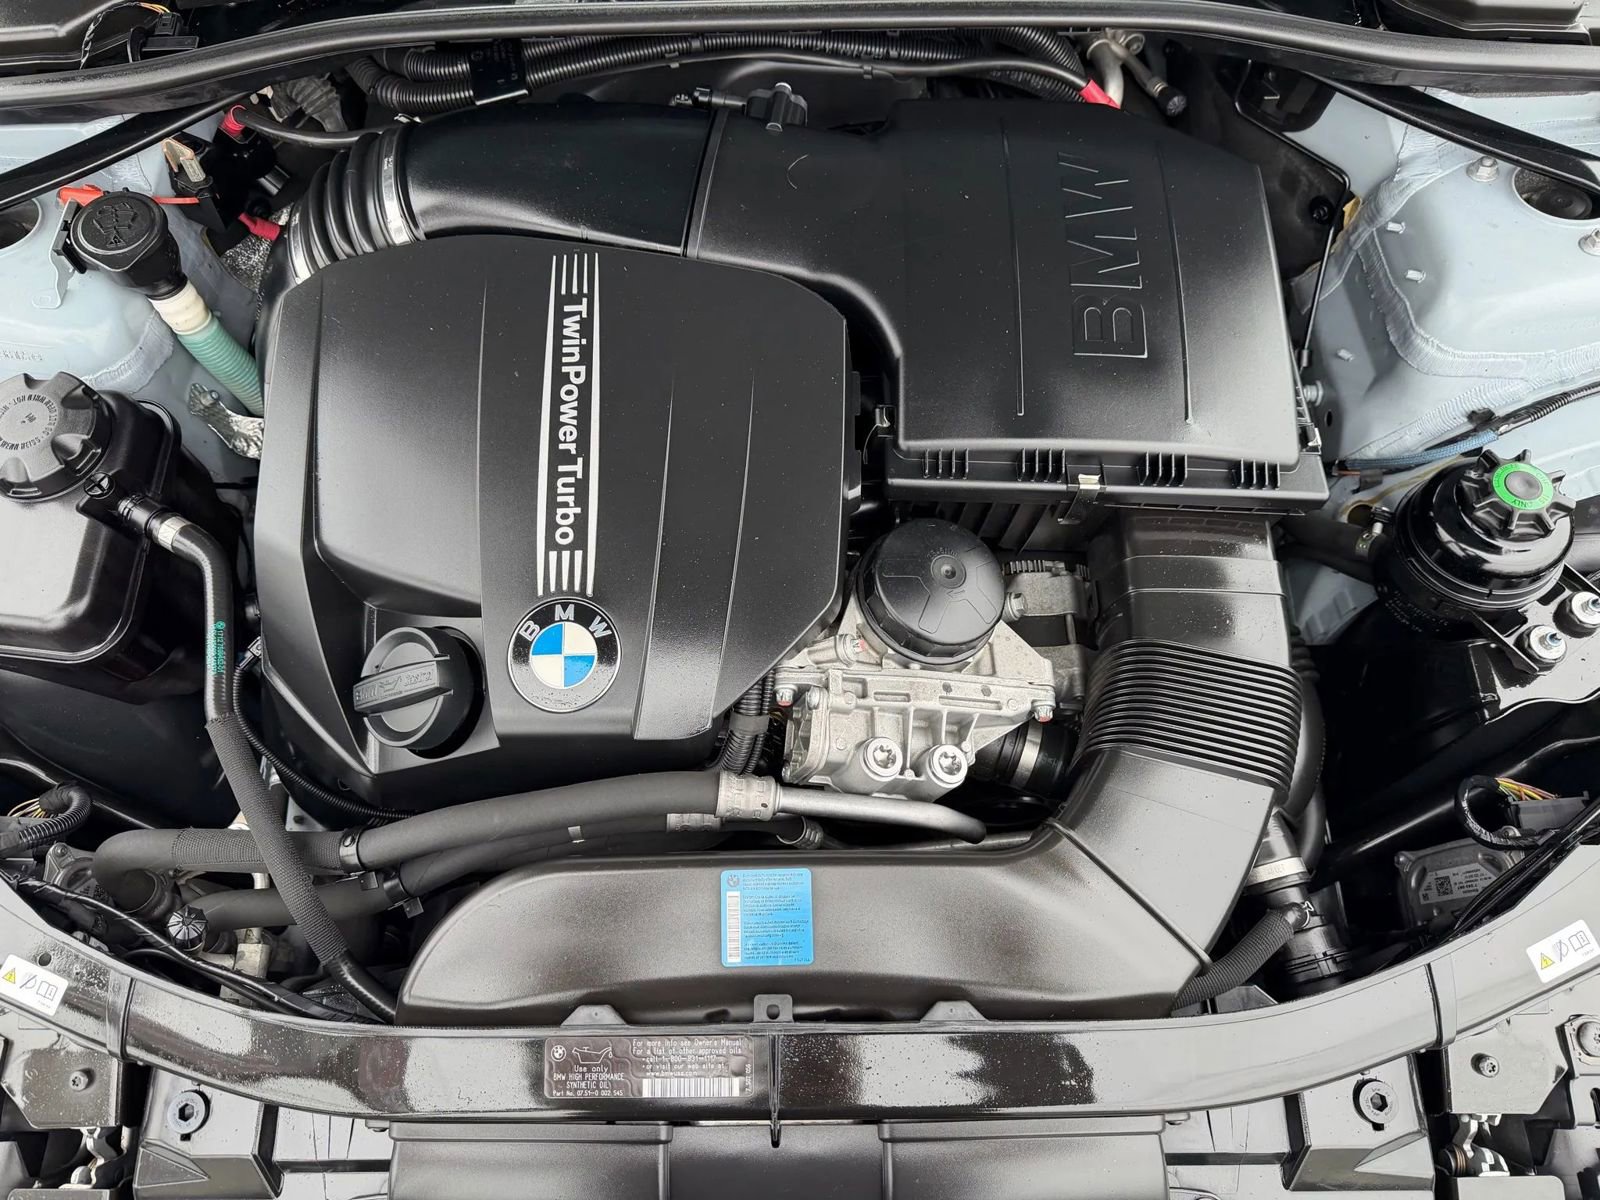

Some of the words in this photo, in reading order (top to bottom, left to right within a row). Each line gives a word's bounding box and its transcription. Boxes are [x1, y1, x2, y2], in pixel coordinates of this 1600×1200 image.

[1057, 152, 1148, 358] BMW
[558, 297, 588, 455] TwinPower
[554, 457, 583, 546] Turbo
[519, 604, 612, 642] BMW
[632, 1038, 643, 1047] For
[720, 1037, 742, 1046] Manual
[632, 1046, 643, 1055] For
[653, 1046, 665, 1055] list
[678, 1047, 695, 1055] other
[698, 1046, 727, 1056] approved
[729, 1046, 742, 1054] oils
[574, 1065, 588, 1073] Use
[591, 1064, 609, 1075] only
[702, 1061, 715, 1069] site
[553, 1073, 566, 1081] BMW
[568, 1073, 583, 1081] HIGH
[584, 1072, 625, 1081] PERFORMANCE
[566, 1080, 597, 1089] SYNTHETIC
[599, 1080, 610, 1089] OIL
